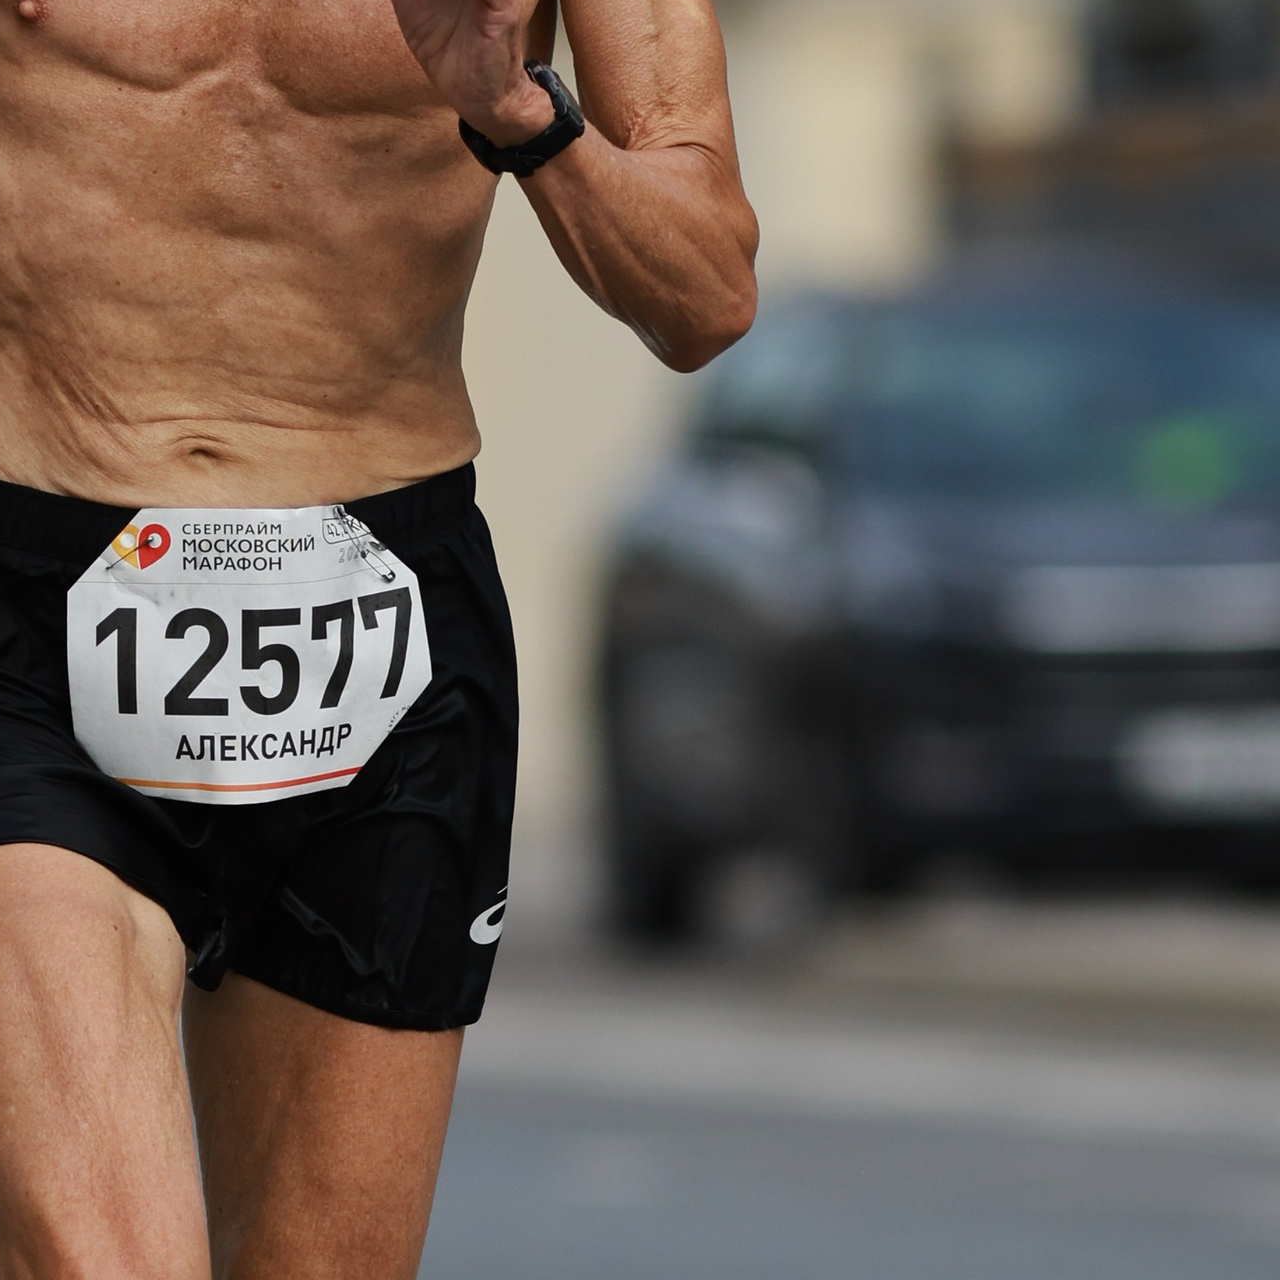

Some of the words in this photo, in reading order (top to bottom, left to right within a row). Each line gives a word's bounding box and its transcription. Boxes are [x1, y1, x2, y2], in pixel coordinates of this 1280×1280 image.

[181, 521, 282, 535] СБЕРПРАЙМ
[182, 534, 315, 554] МОСКОВСКИЙ
[182, 556, 282, 571] МАРАФОН
[95, 586, 413, 716] 12577
[175, 723, 352, 762] АЛЕКСАНДР
